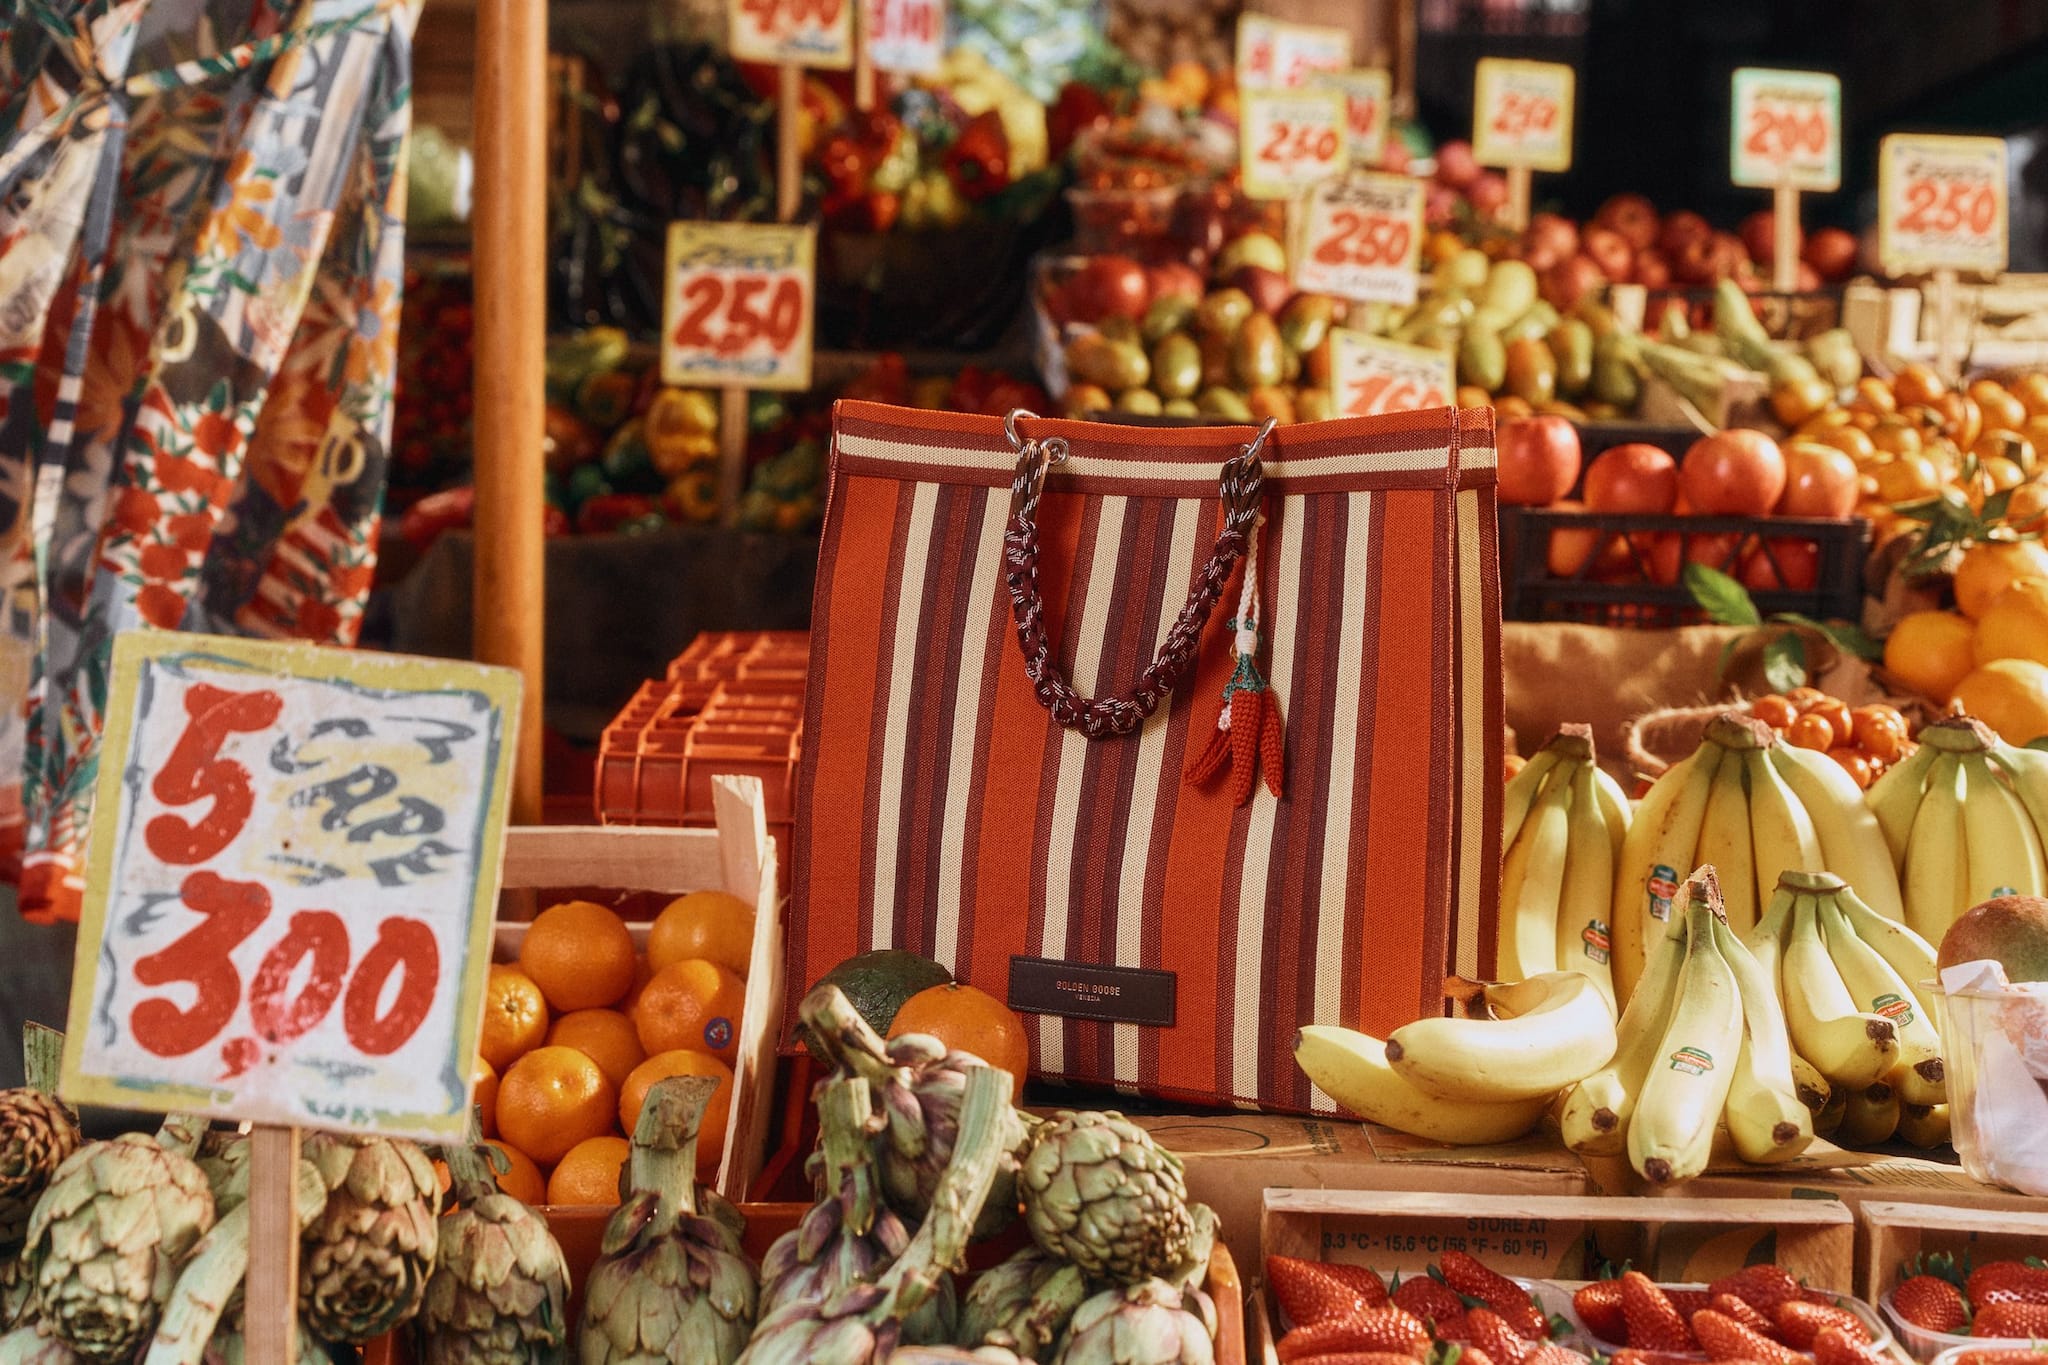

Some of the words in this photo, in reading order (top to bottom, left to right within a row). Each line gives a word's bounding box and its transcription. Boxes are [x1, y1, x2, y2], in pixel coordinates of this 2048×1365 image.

[143, 682, 284, 866] 5
[1056, 980, 1089, 993] GOLDEN
[1092, 984, 1121, 996] GOOSE
[1467, 1217, 1523, 1233] STORE
[1527, 1218, 1548, 1234] AT
[1385, 1233, 1416, 1252] 15.6
[1503, 1239, 1521, 1256] 60
